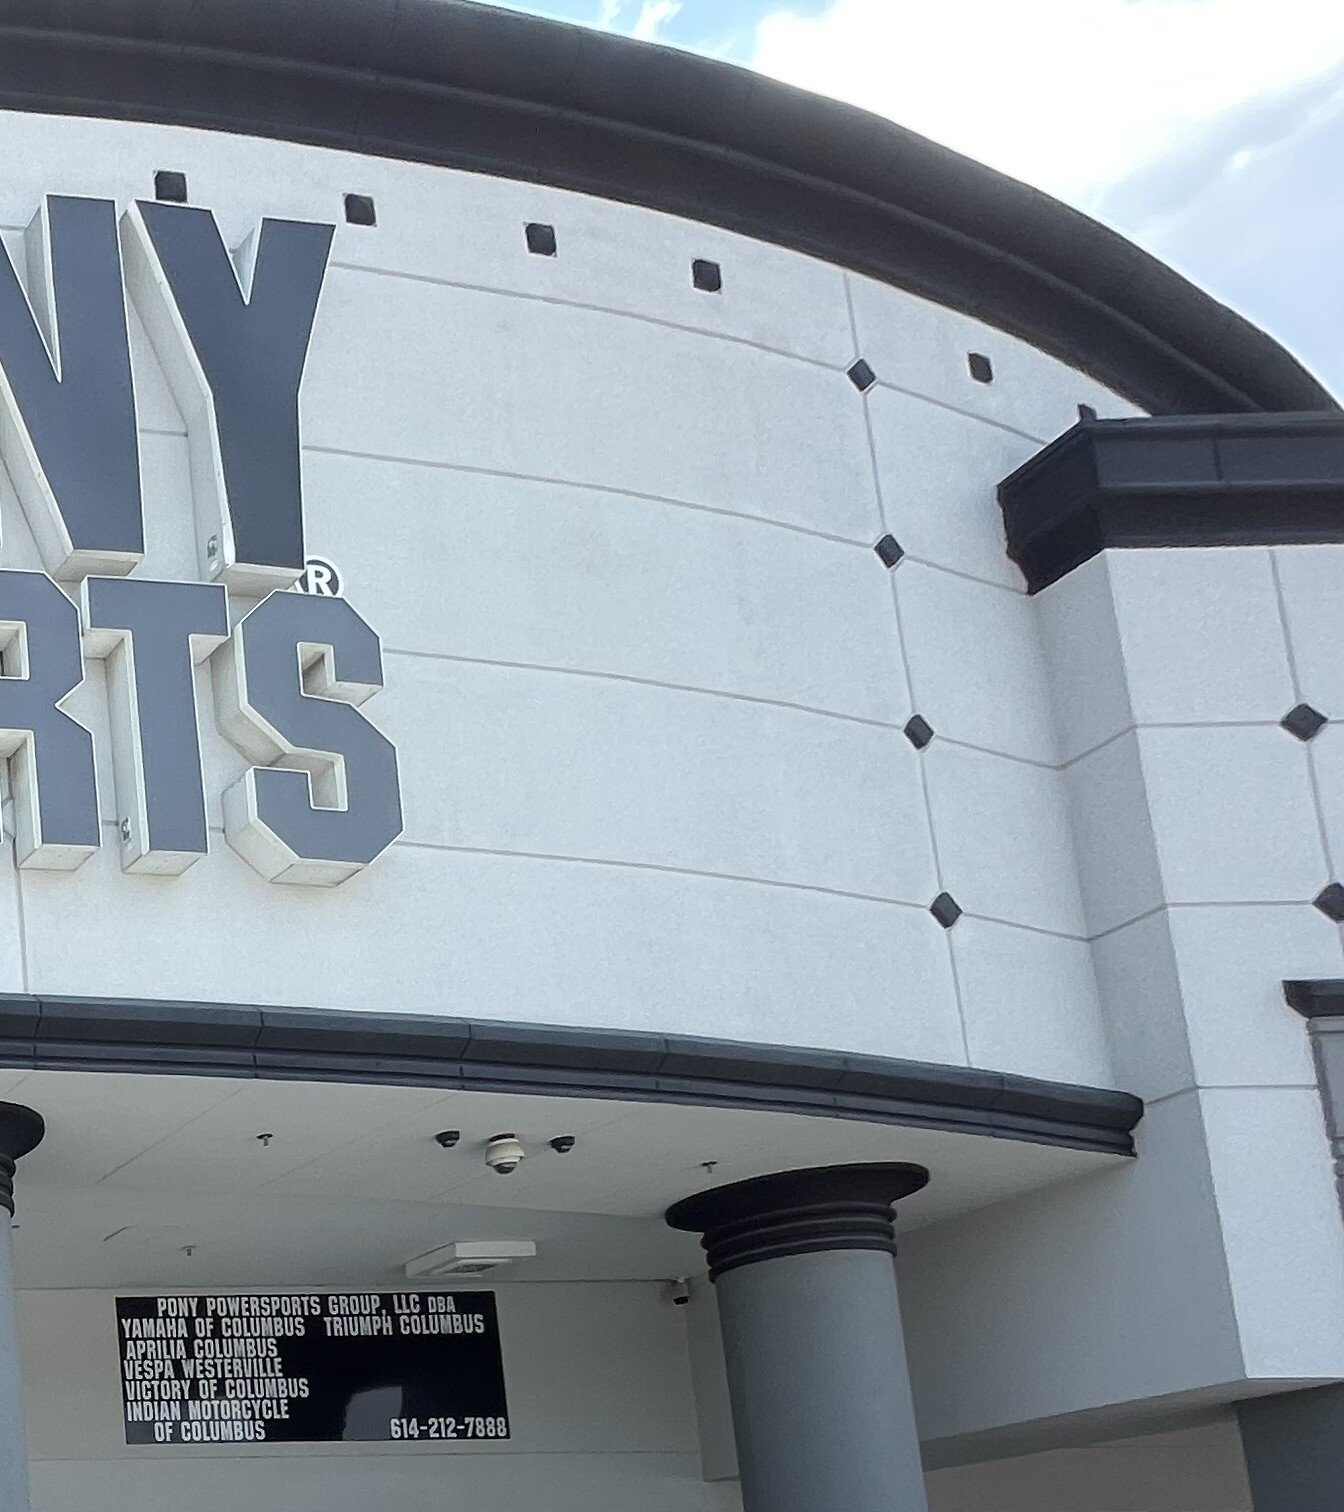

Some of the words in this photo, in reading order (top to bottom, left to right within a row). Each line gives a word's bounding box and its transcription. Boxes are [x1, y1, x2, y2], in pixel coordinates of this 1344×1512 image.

[157, 1297, 198, 1317] PONY
[206, 1296, 321, 1317] POWERSPORTS
[328, 1294, 387, 1316] GROUP,
[393, 1294, 421, 1314] LLC
[428, 1296, 456, 1313] DBA
[121, 1318, 189, 1338] YAMAHA
[195, 1318, 214, 1337] OF
[221, 1317, 306, 1337] COLUMBUS
[324, 1316, 393, 1336] TRIUMPH
[400, 1314, 485, 1334] COLUMBUS
[126, 1340, 187, 1360] APRILIA
[193, 1338, 278, 1358] COLUMBUS
[124, 1360, 175, 1379] VESPA
[181, 1358, 284, 1378] WESTERVILLE
[125, 1380, 191, 1400] VICTORY
[198, 1379, 217, 1399] OF
[224, 1378, 310, 1398] COLUMBUS
[126, 1401, 181, 1421] INDIAN
[187, 1399, 290, 1420] MOTORCYCLE
[153, 1421, 174, 1442] OF
[180, 1421, 266, 1441] COLUMBUS
[390, 1417, 507, 1438] 614-212-7888
